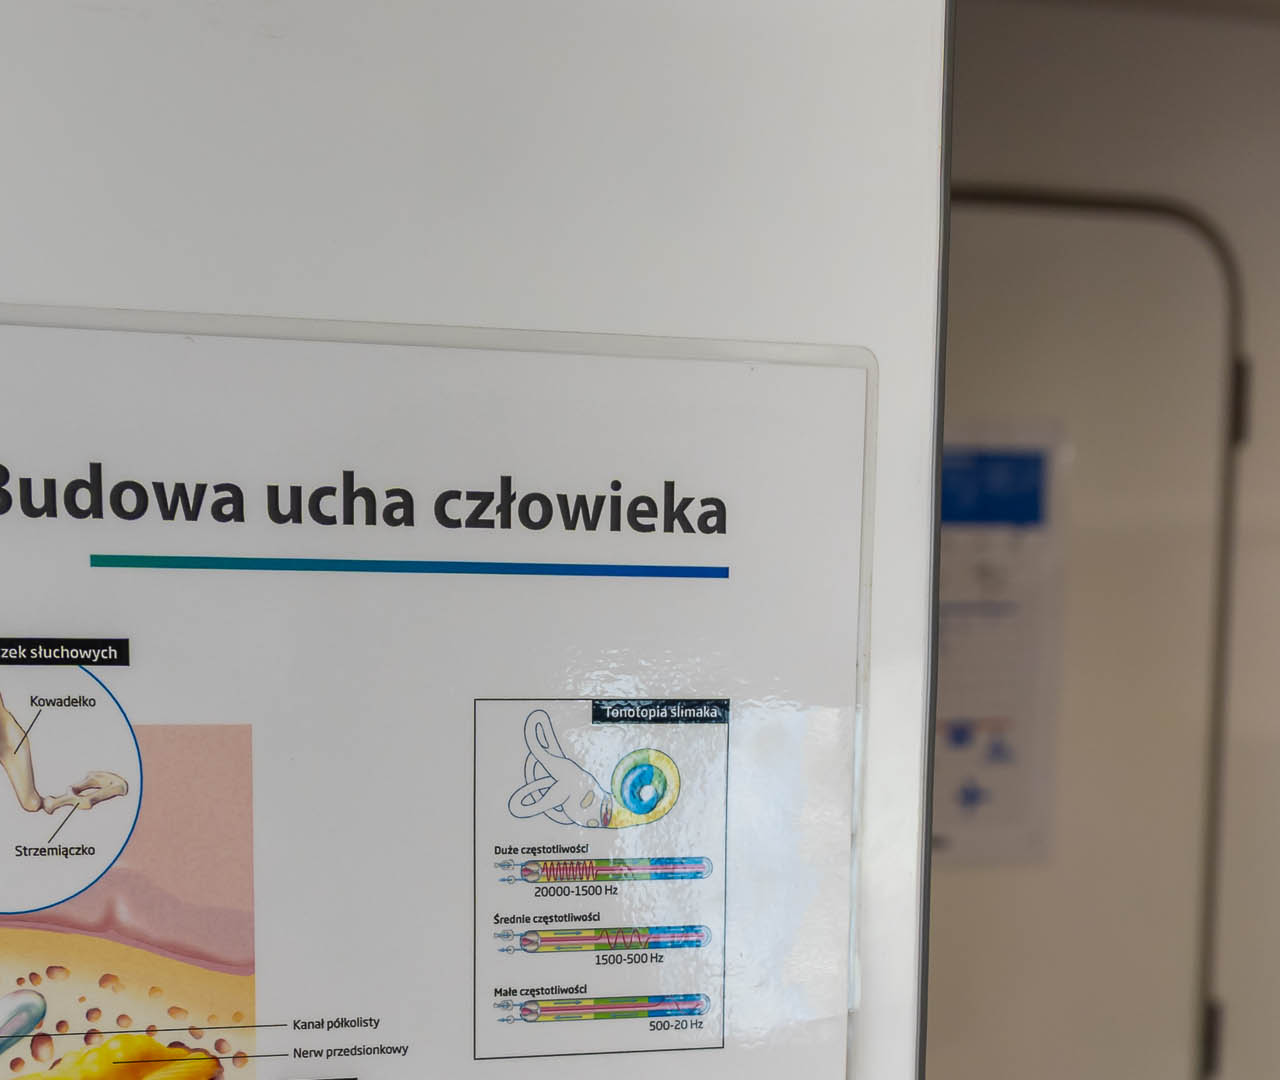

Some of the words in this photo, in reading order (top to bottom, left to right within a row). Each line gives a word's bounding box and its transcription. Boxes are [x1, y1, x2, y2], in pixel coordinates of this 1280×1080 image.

[265, 470, 415, 526] ucha
[434, 475, 728, 534] człowieka
[30, 645, 118, 662] słuchowych
[30, 695, 96, 708] Kowadełko
[605, 705, 668, 719] Tonotopia
[670, 704, 718, 718] ślimaka
[15, 845, 96, 858] Strzemiączko
[494, 845, 519, 855] Duże
[520, 843, 589, 856] częstotliwości
[534, 885, 602, 897] 20000-1500
[604, 885, 618, 896] Hz
[493, 914, 531, 925] Średnie
[533, 912, 600, 925] częstotliwości
[595, 954, 648, 965] 1500-500
[650, 953, 664, 964] Hz
[494, 987, 518, 997] Małe
[519, 984, 587, 997] częstotliwości
[293, 1018, 324, 1030] Kanał
[326, 1017, 380, 1031] półkolisty
[649, 1020, 688, 1031] 500-20
[690, 1020, 703, 1030] Hz
[293, 1048, 323, 1058] Nerw
[326, 1044, 409, 1059] przedsionkowy
